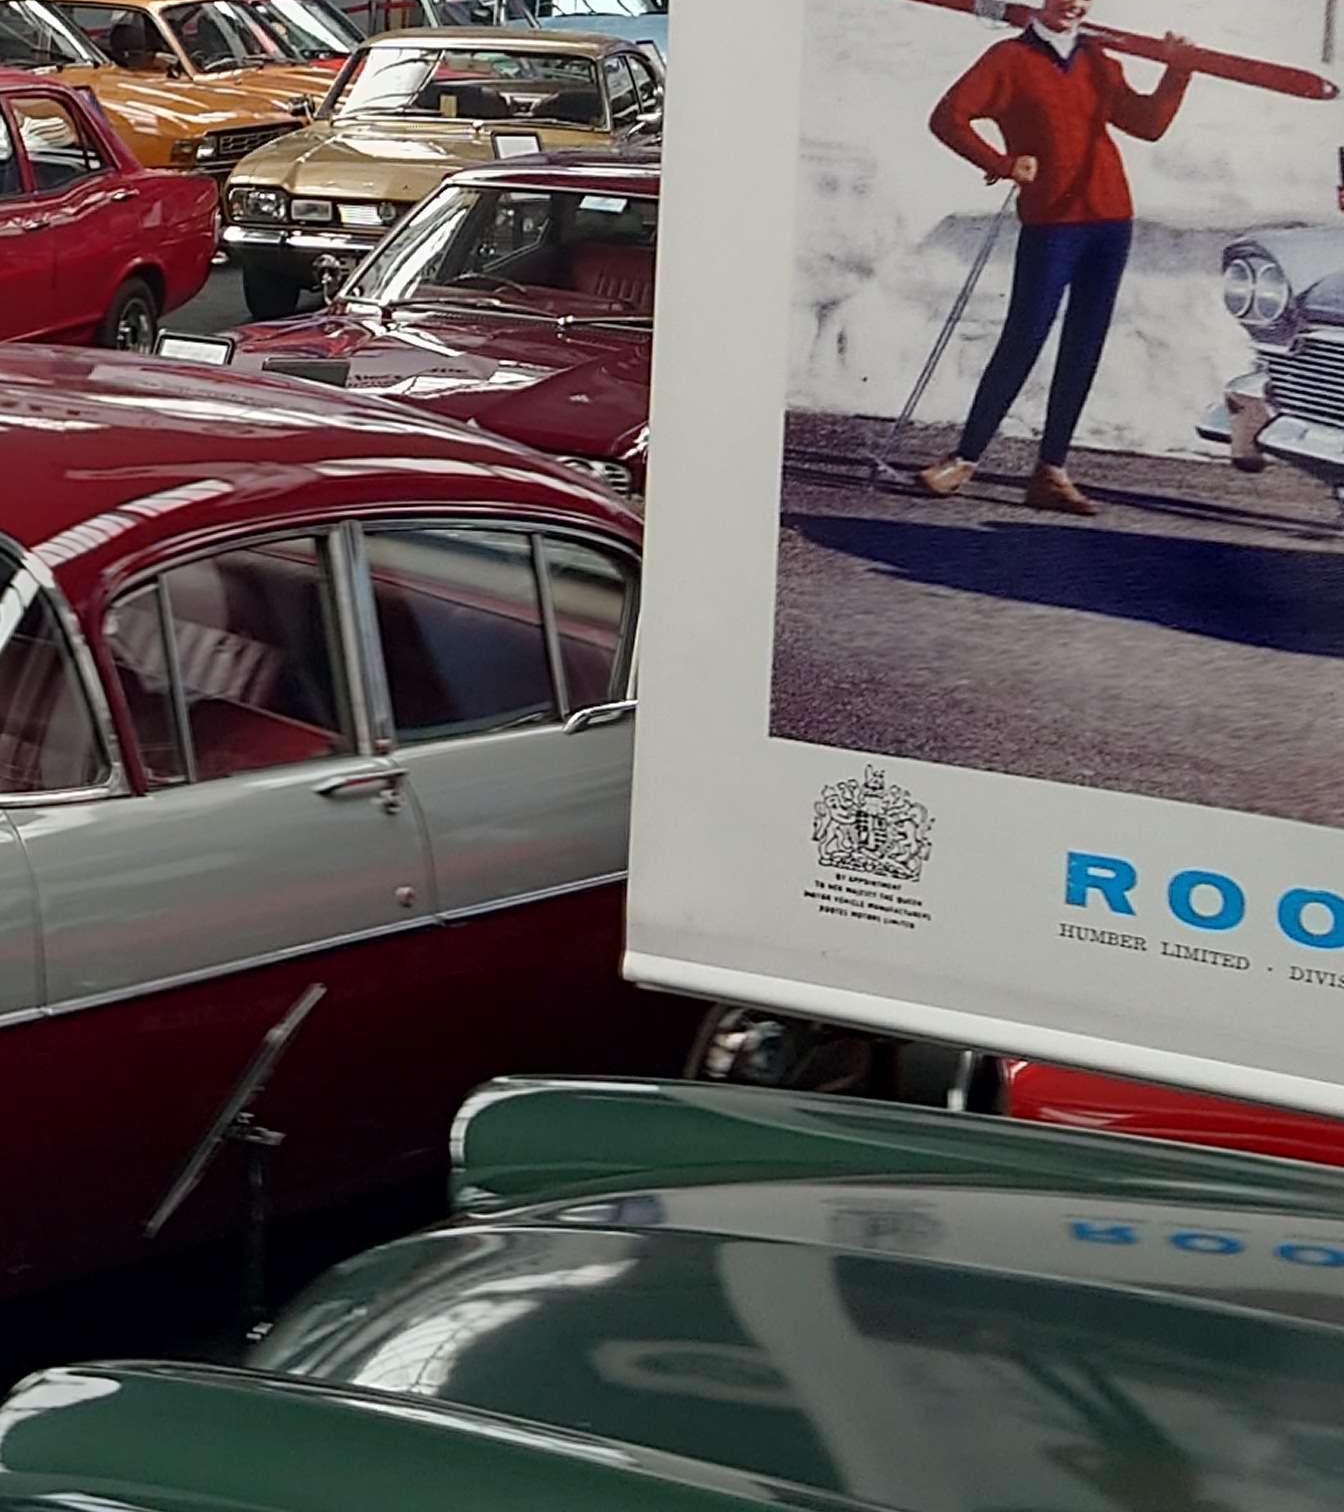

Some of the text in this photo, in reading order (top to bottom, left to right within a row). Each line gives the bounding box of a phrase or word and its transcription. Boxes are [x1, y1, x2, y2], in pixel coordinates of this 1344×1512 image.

[1065, 851, 1344, 950] ROO
[1060, 923, 1148, 952] HUMBER
[1160, 941, 1250, 971] LIMITED
